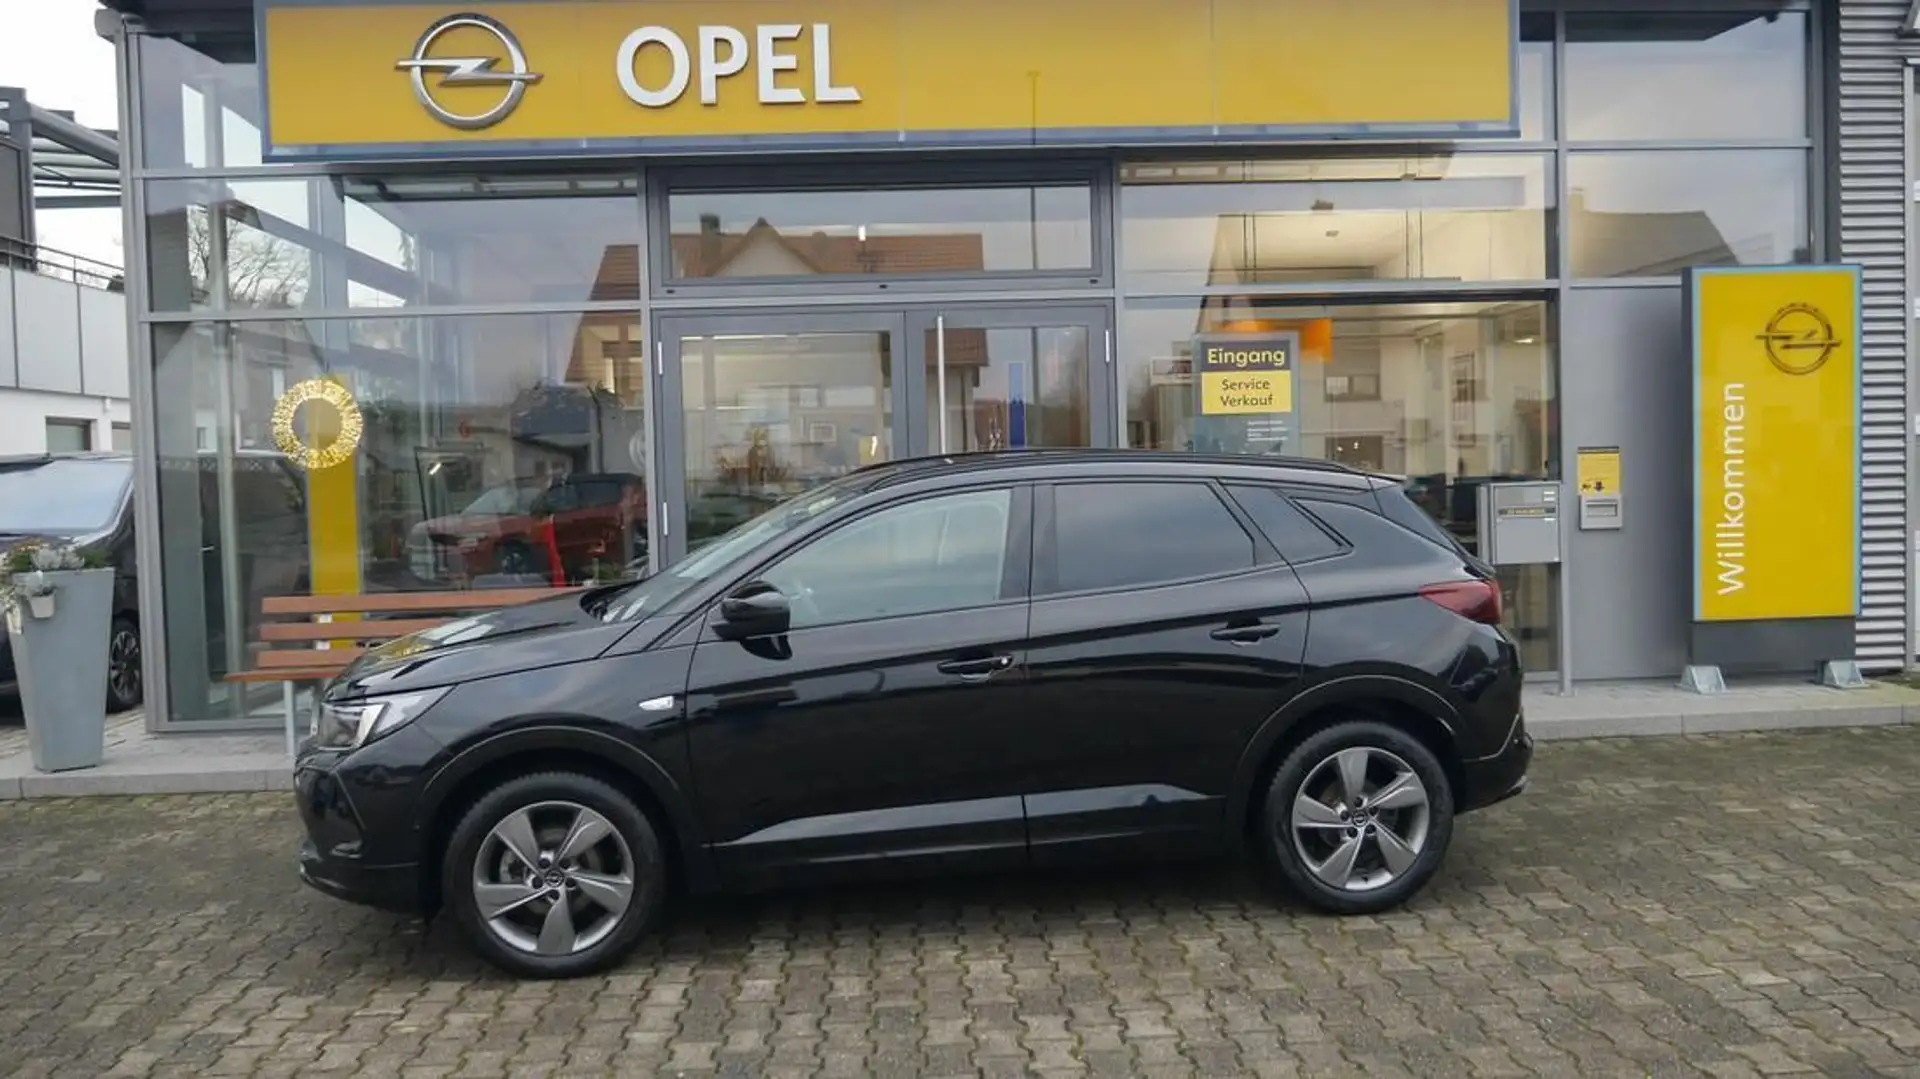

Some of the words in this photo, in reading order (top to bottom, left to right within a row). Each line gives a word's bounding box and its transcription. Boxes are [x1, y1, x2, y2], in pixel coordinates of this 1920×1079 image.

[616, 23, 862, 106] OPEL
[1207, 347, 1285, 368] Eingang
[1221, 378, 1271, 391] Service
[1220, 394, 1273, 407] Verkauf
[1715, 382, 1745, 596] Willkommen
